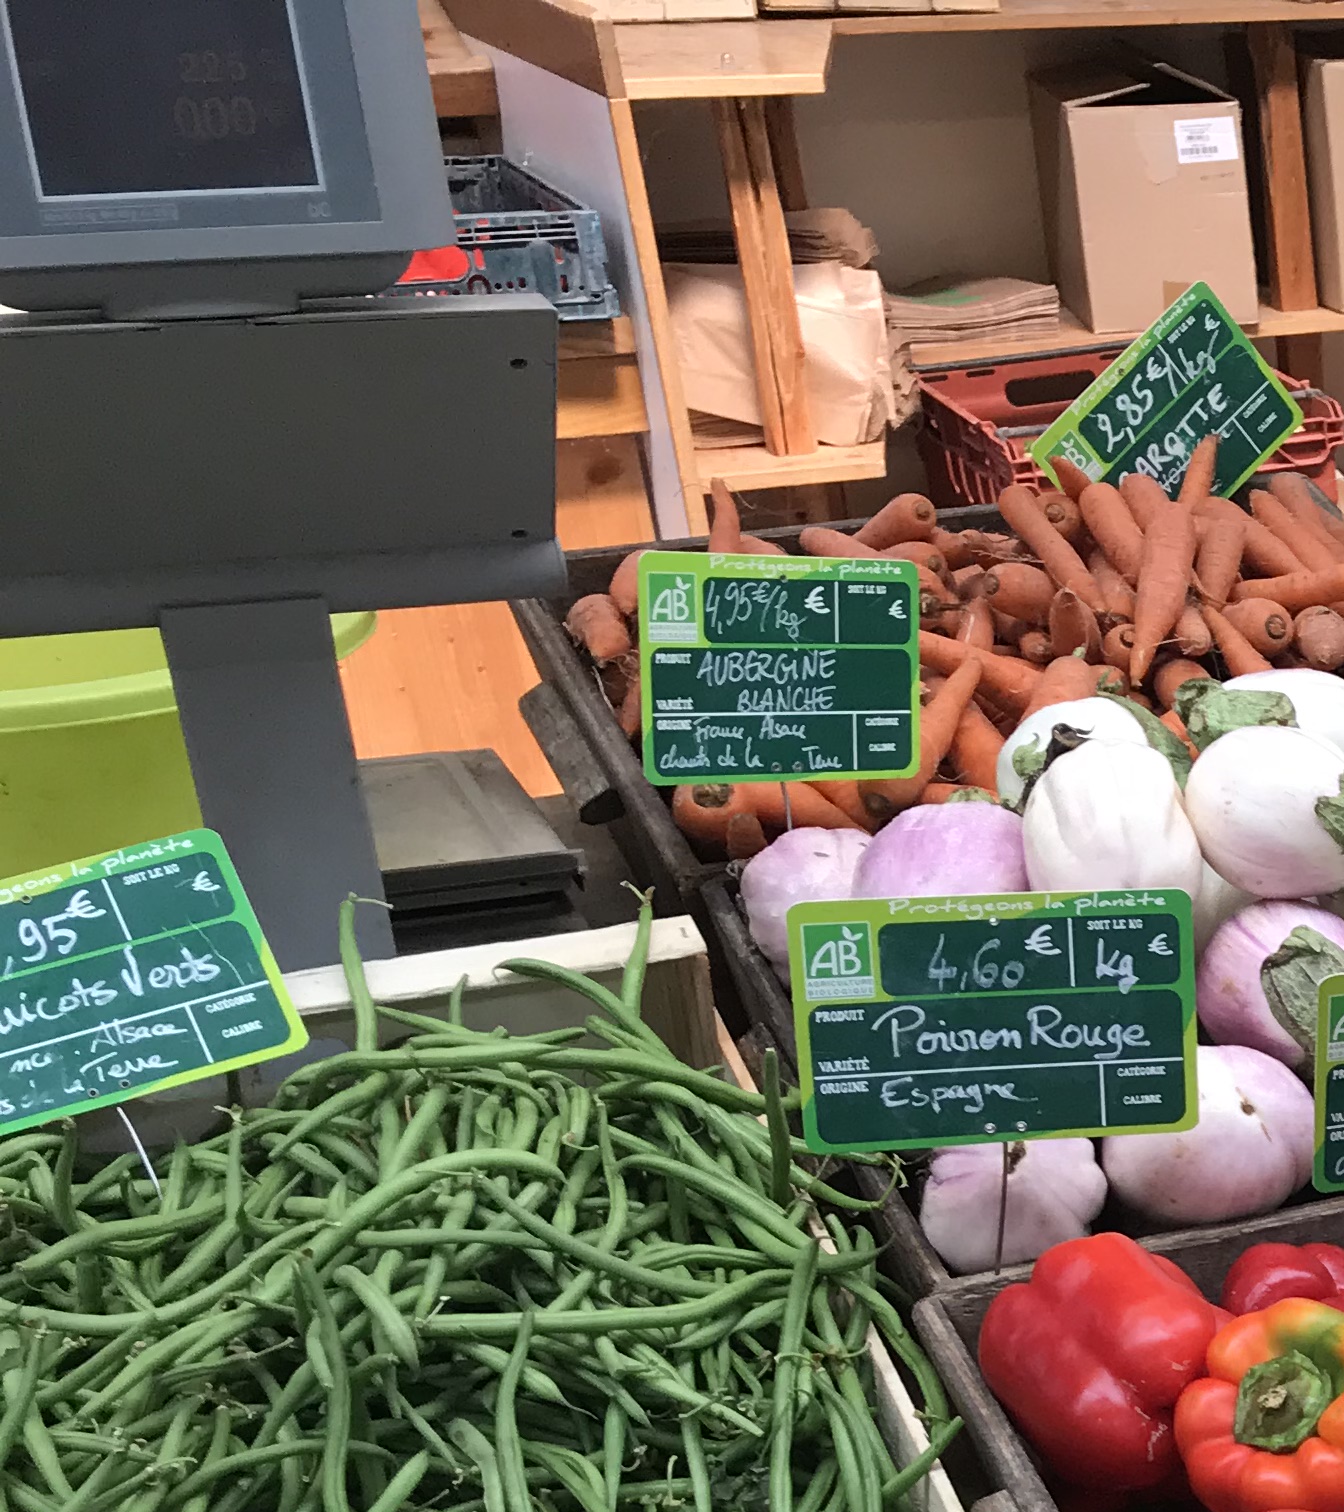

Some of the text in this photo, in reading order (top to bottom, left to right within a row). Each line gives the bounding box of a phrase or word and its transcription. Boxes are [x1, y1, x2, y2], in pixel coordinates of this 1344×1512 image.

[709, 556, 902, 582] Protégeons planète
[804, 586, 831, 614] €
[888, 600, 906, 619] €
[736, 685, 836, 712] BLANCHE
[717, 746, 738, 767] de
[70, 838, 194, 878] la planète
[192, 870, 221, 892] €
[888, 892, 1166, 919] Protégeons la planète
[1087, 919, 1126, 930] SOIT LE
[120, 944, 221, 997] Verts
[810, 942, 862, 977] AB
[928, 924, 1062, 992] 4,60 €
[1095, 933, 1174, 994] kg €
[221, 1021, 263, 1038] CALIBRE
[815, 1009, 865, 1023] PRODUIT
[91, 1019, 188, 1052] Alsace
[871, 1004, 1151, 1059] Poivron Rouge
[79, 1052, 179, 1082] Terre
[818, 1058, 871, 1073] VARIÉTÉ
[1117, 1066, 1166, 1077] CATÉGORIE
[820, 1080, 869, 1094] ORIGINE
[880, 1077, 1024, 1113] Espagne
[1123, 1094, 1163, 1105] CALIBRE
